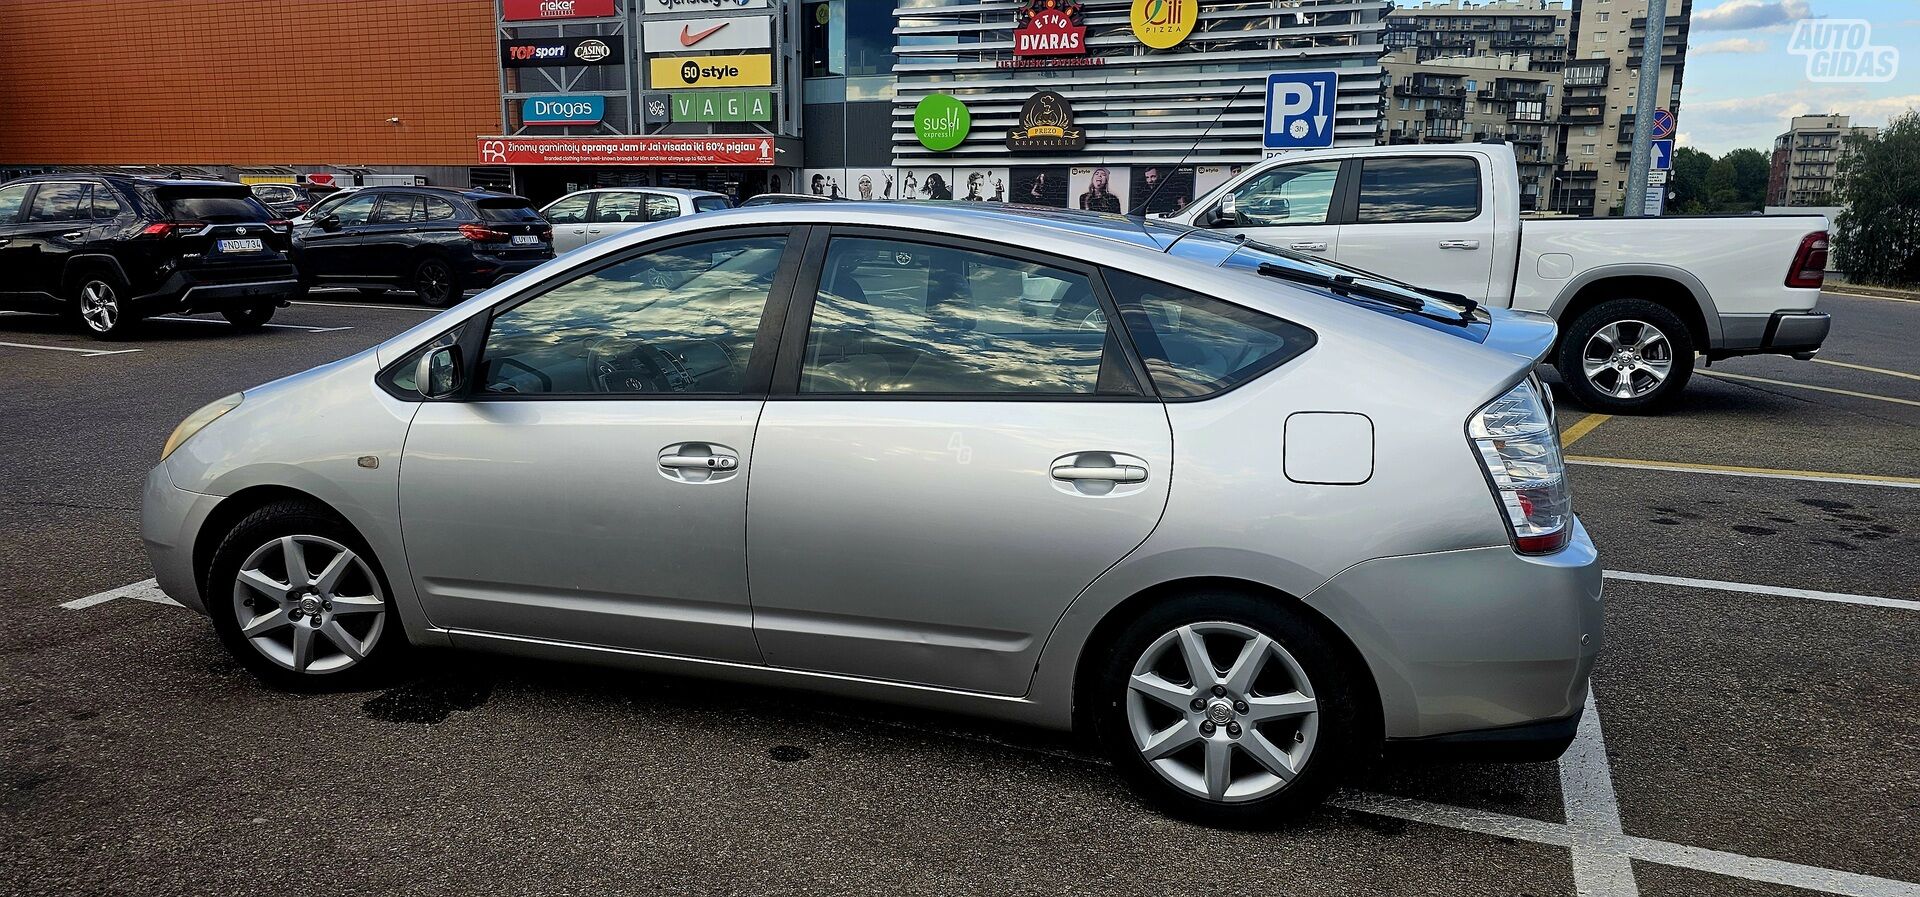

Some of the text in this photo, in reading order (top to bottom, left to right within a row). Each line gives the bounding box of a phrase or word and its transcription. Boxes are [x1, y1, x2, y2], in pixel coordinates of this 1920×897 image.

[540, 0, 575, 10] rieker
[1035, 14, 1067, 29] ETNO
[1020, 33, 1079, 50] DVARAS
[574, 45, 611, 58] CASINO
[684, 65, 739, 80] 50 style
[535, 101, 592, 118] Drogas
[1270, 82, 1313, 134] P
[923, 107, 961, 133] SUSHI
[923, 131, 949, 139] express
[1034, 127, 1057, 135] PREZO
[1294, 125, 1304, 133] 3h
[508, 142, 537, 153] Žinomų
[539, 142, 580, 154] gamintojų
[581, 143, 618, 154] apranga
[619, 143, 639, 152] Jam
[640, 142, 646, 151] ir
[647, 142, 661, 152] Jai
[662, 142, 693, 151] visada
[694, 142, 705, 151] iki
[705, 142, 725, 151] 60%
[726, 142, 756, 153] pigiau
